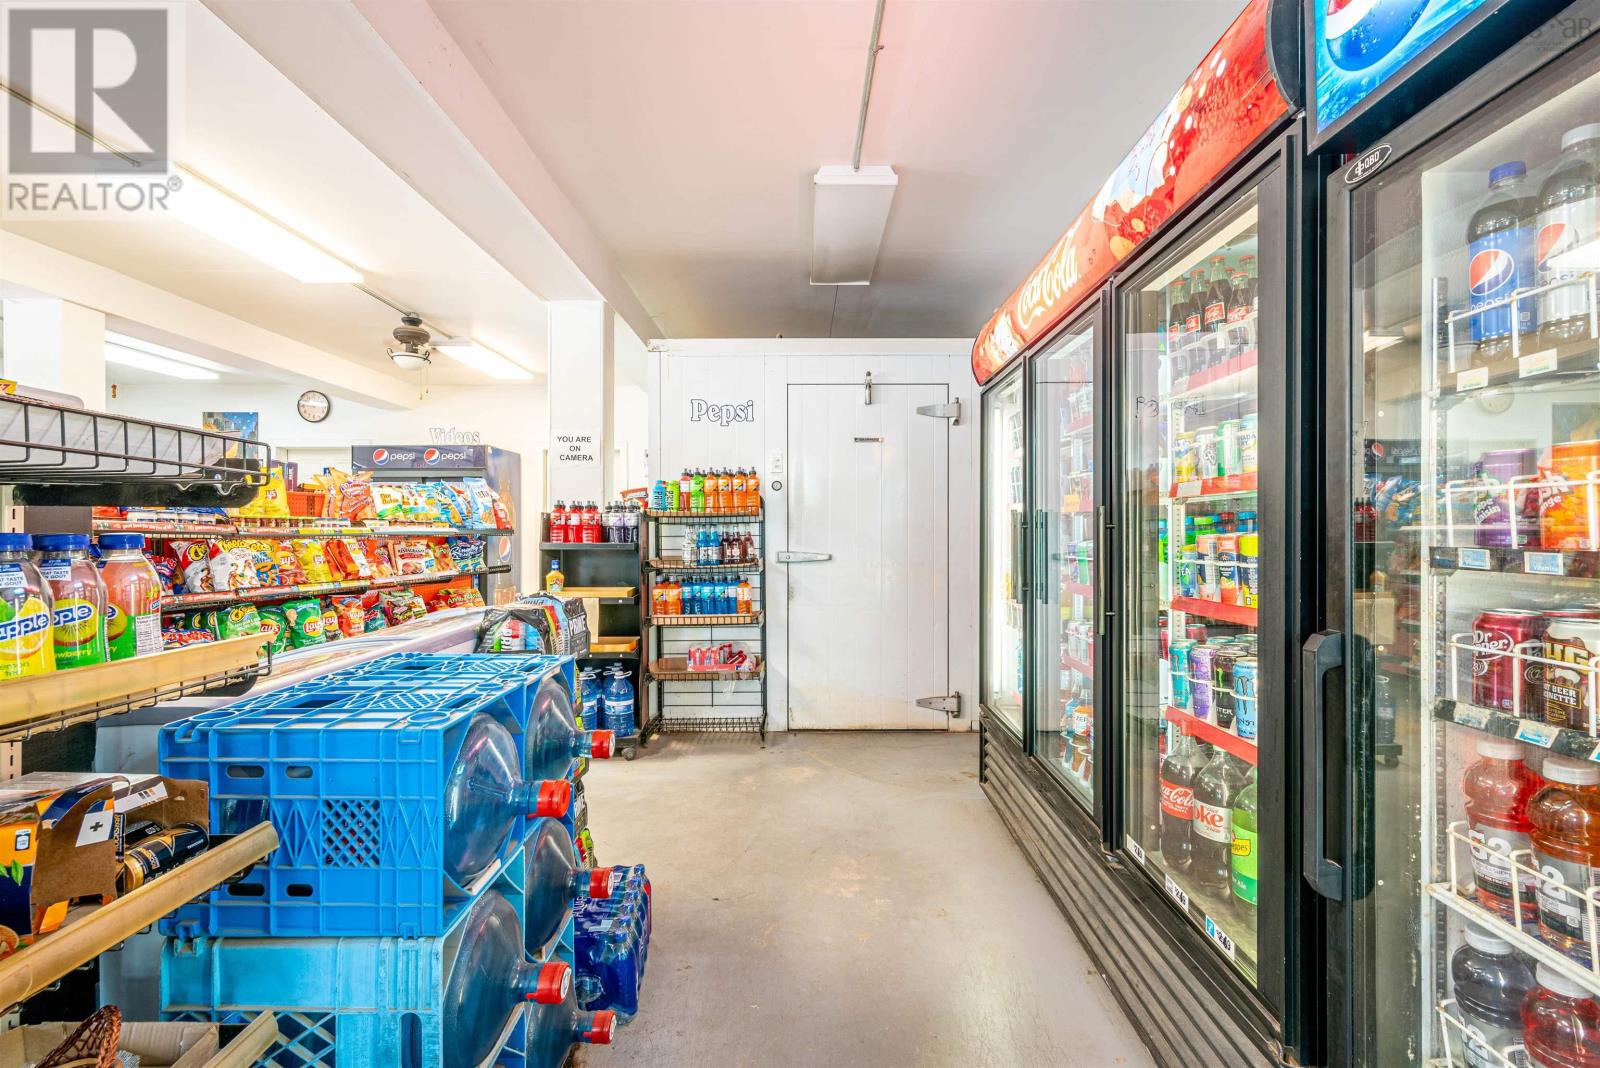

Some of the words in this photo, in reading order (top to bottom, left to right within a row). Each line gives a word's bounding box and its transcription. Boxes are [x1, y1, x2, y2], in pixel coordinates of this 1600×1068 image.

[690, 398, 755, 427] Pepsi
[429, 427, 480, 445] Videos
[390, 451, 416, 462] pepsi
[441, 451, 466, 462] pepsi
[559, 454, 594, 462] CAMERA
[1473, 630, 1492, 644] Dr
[1551, 684, 1577, 697] BEER
